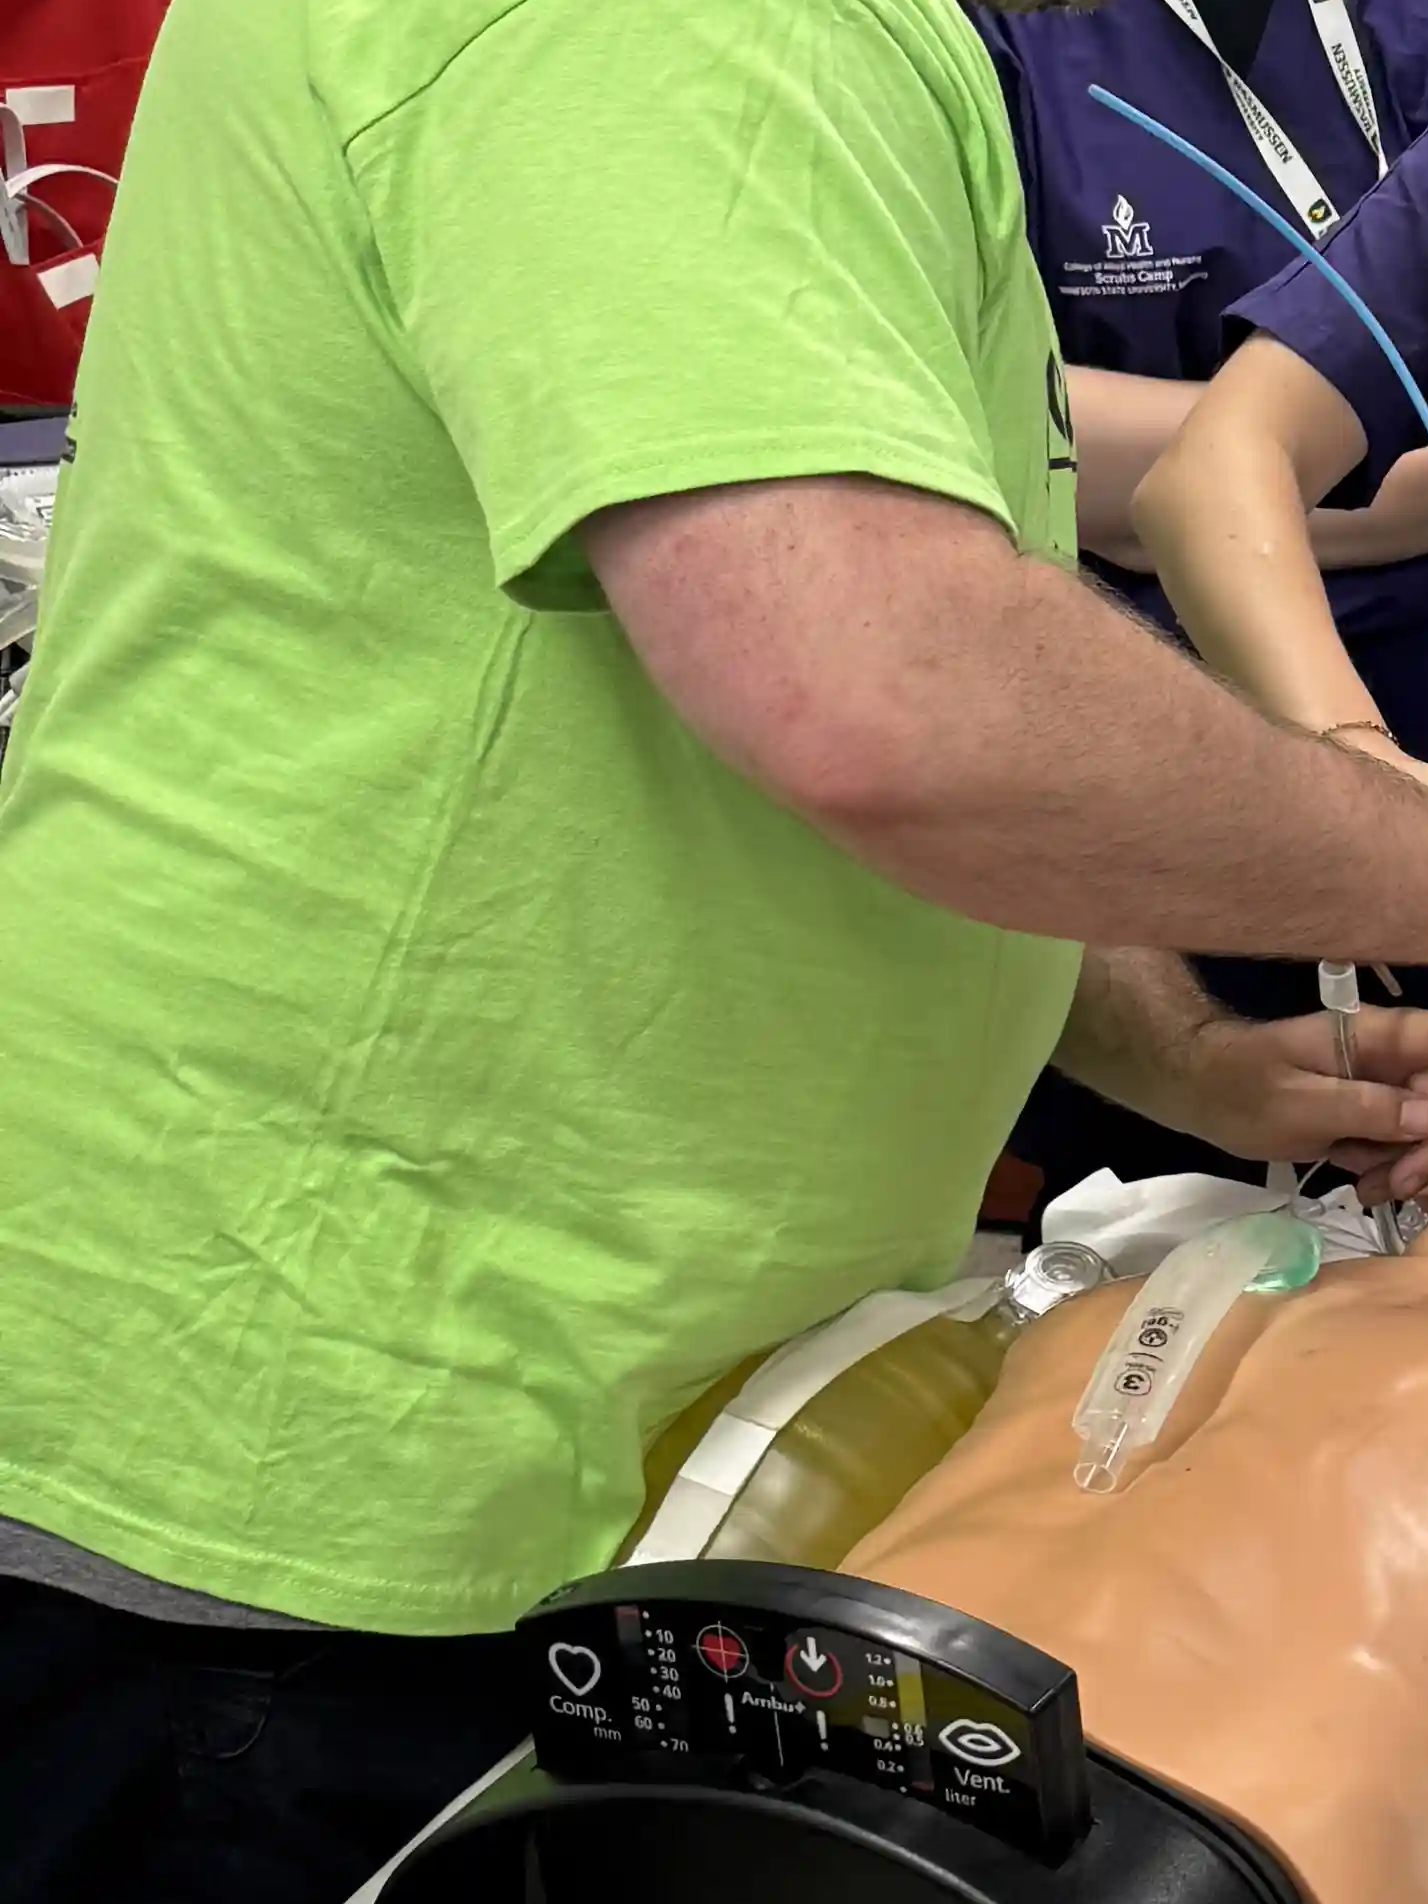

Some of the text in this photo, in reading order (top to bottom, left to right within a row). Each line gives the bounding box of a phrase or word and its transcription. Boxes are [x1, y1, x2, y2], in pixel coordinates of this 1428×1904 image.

[1331, 42, 1375, 133] RASMUSSEN
[1232, 77, 1293, 164] RASMUSSEN
[1102, 222, 1154, 259] M
[1094, 270, 1174, 285] Scrubs Camp
[655, 1629, 675, 1645] 10
[657, 1647, 677, 1663] 20
[865, 1652, 883, 1666] 1.2
[659, 1666, 680, 1683] 30
[868, 1674, 885, 1687] 1.0
[662, 1684, 682, 1700] 40
[549, 1694, 612, 1725] Comp.
[631, 1696, 651, 1712] 50
[741, 1691, 794, 1714] Ambu
[868, 1695, 887, 1709] 0.8
[634, 1714, 654, 1731] 60
[593, 1725, 623, 1741] mm
[873, 1738, 893, 1753] 0.4
[876, 1759, 897, 1773] 0.2
[953, 1766, 1012, 1795] Vent.
[944, 1787, 977, 1807] liter
